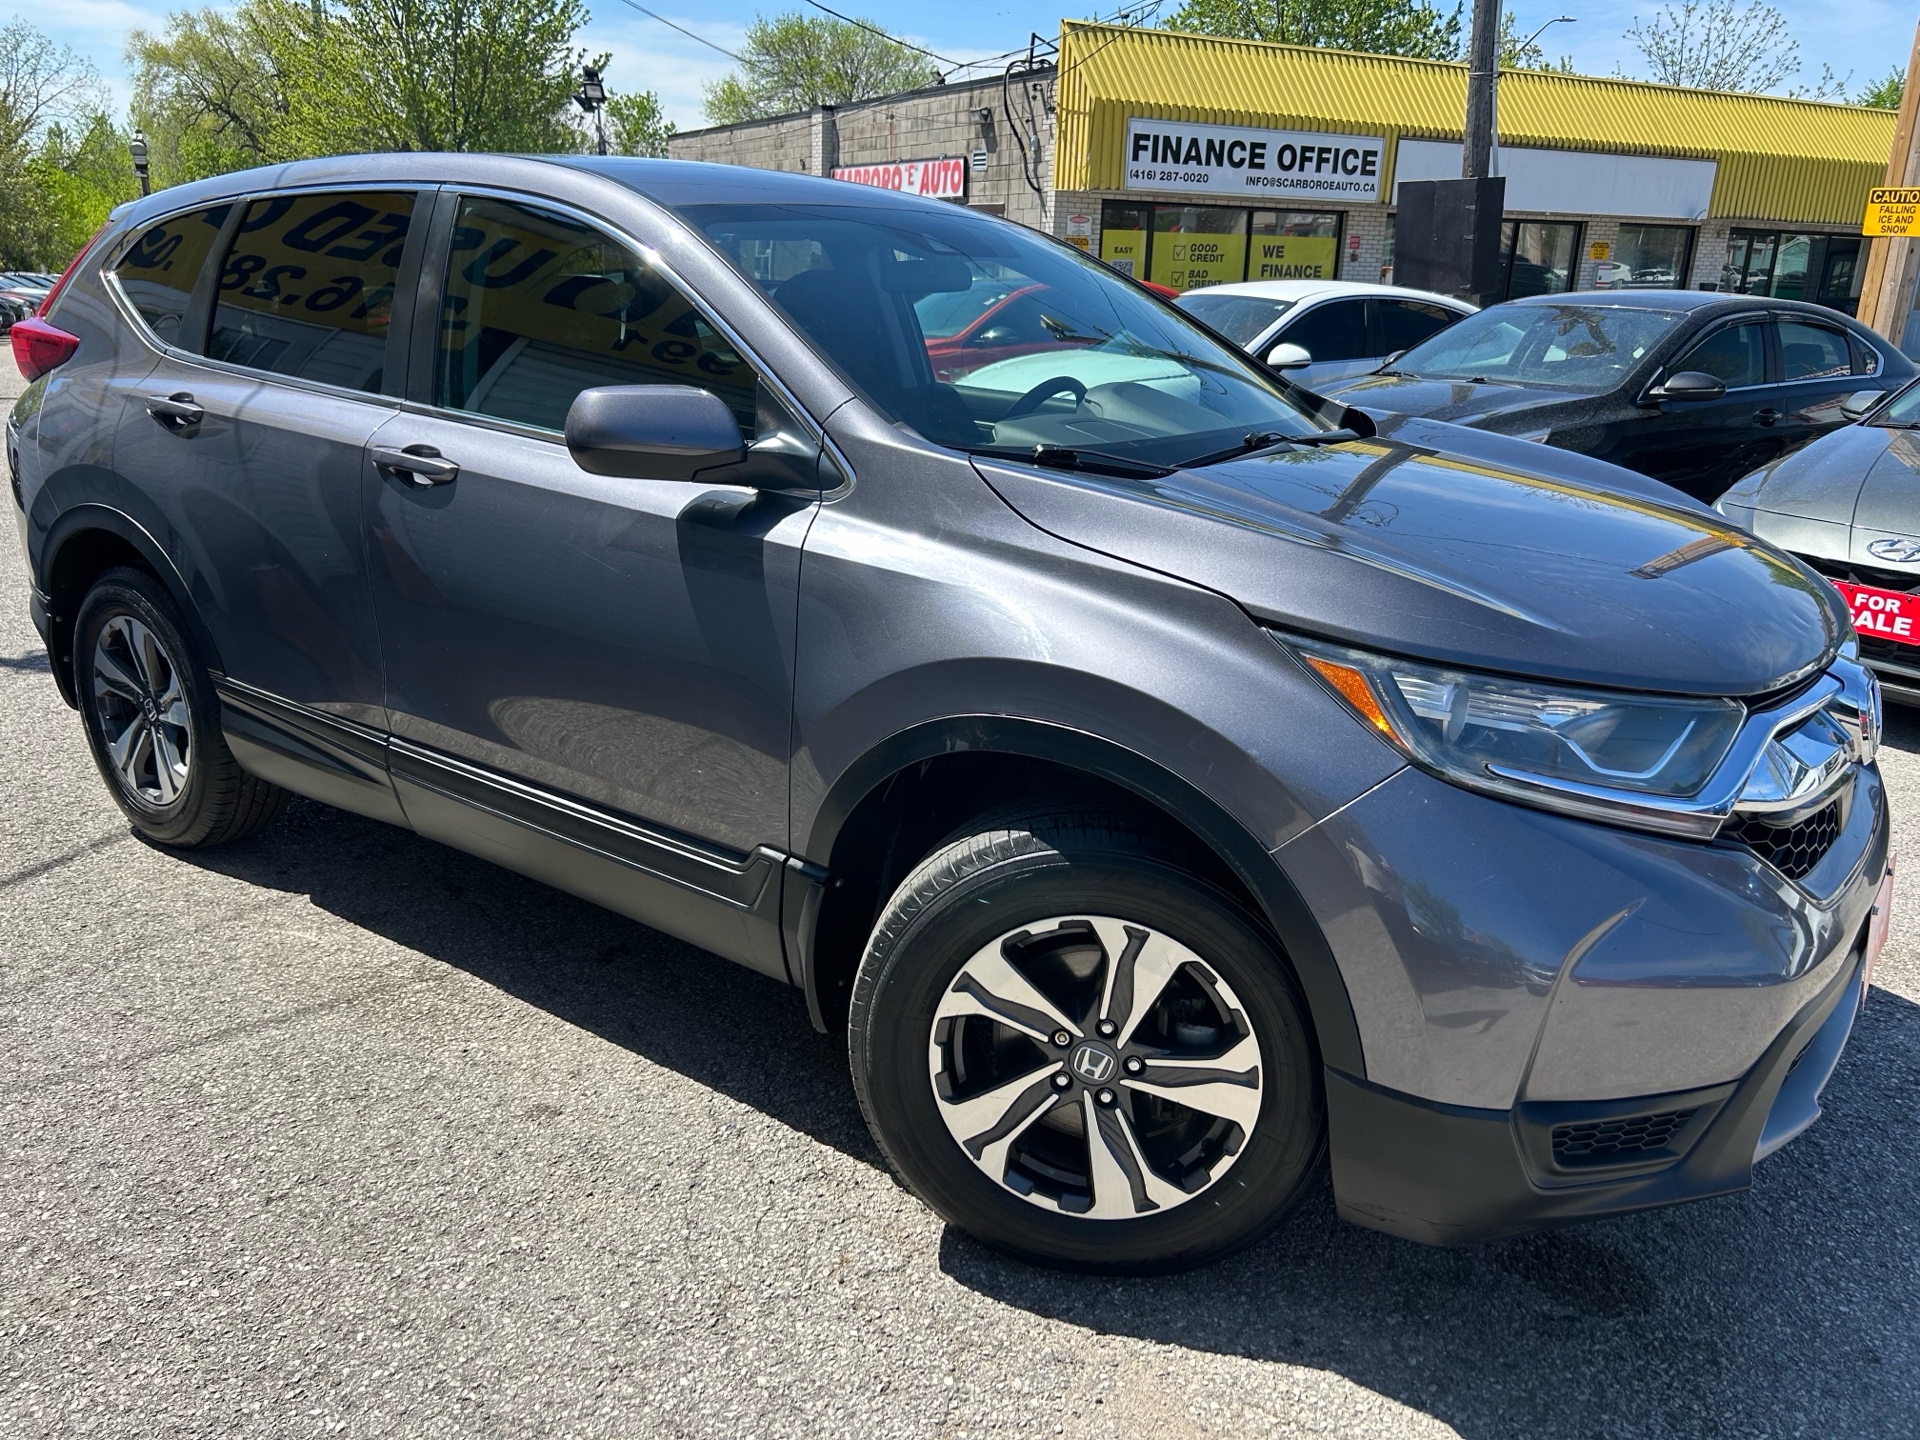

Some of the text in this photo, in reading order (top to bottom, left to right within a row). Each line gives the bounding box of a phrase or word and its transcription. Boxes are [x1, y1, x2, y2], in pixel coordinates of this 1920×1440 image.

[1131, 132, 1378, 177] FINANCE OFFICE
[919, 160, 962, 195] AUTO
[1129, 169, 1209, 183] (416) 287-0020
[1245, 175, 1376, 193] INFO@SCARBOROEAUTO.CA
[1872, 190, 1920, 203] CAUTIO
[1879, 205, 1917, 214] FALLING
[1878, 215, 1914, 224] ICE AND
[1880, 225, 1909, 234] SNOW
[1114, 246, 1134, 254] EASY
[1190, 243, 1218, 253] GOOD
[1262, 244, 1285, 259] WE
[1189, 253, 1225, 263] CREDIT
[1188, 269, 1209, 279] BAD
[1260, 264, 1323, 279] FINANCE
[1854, 592, 1902, 614] FOR
